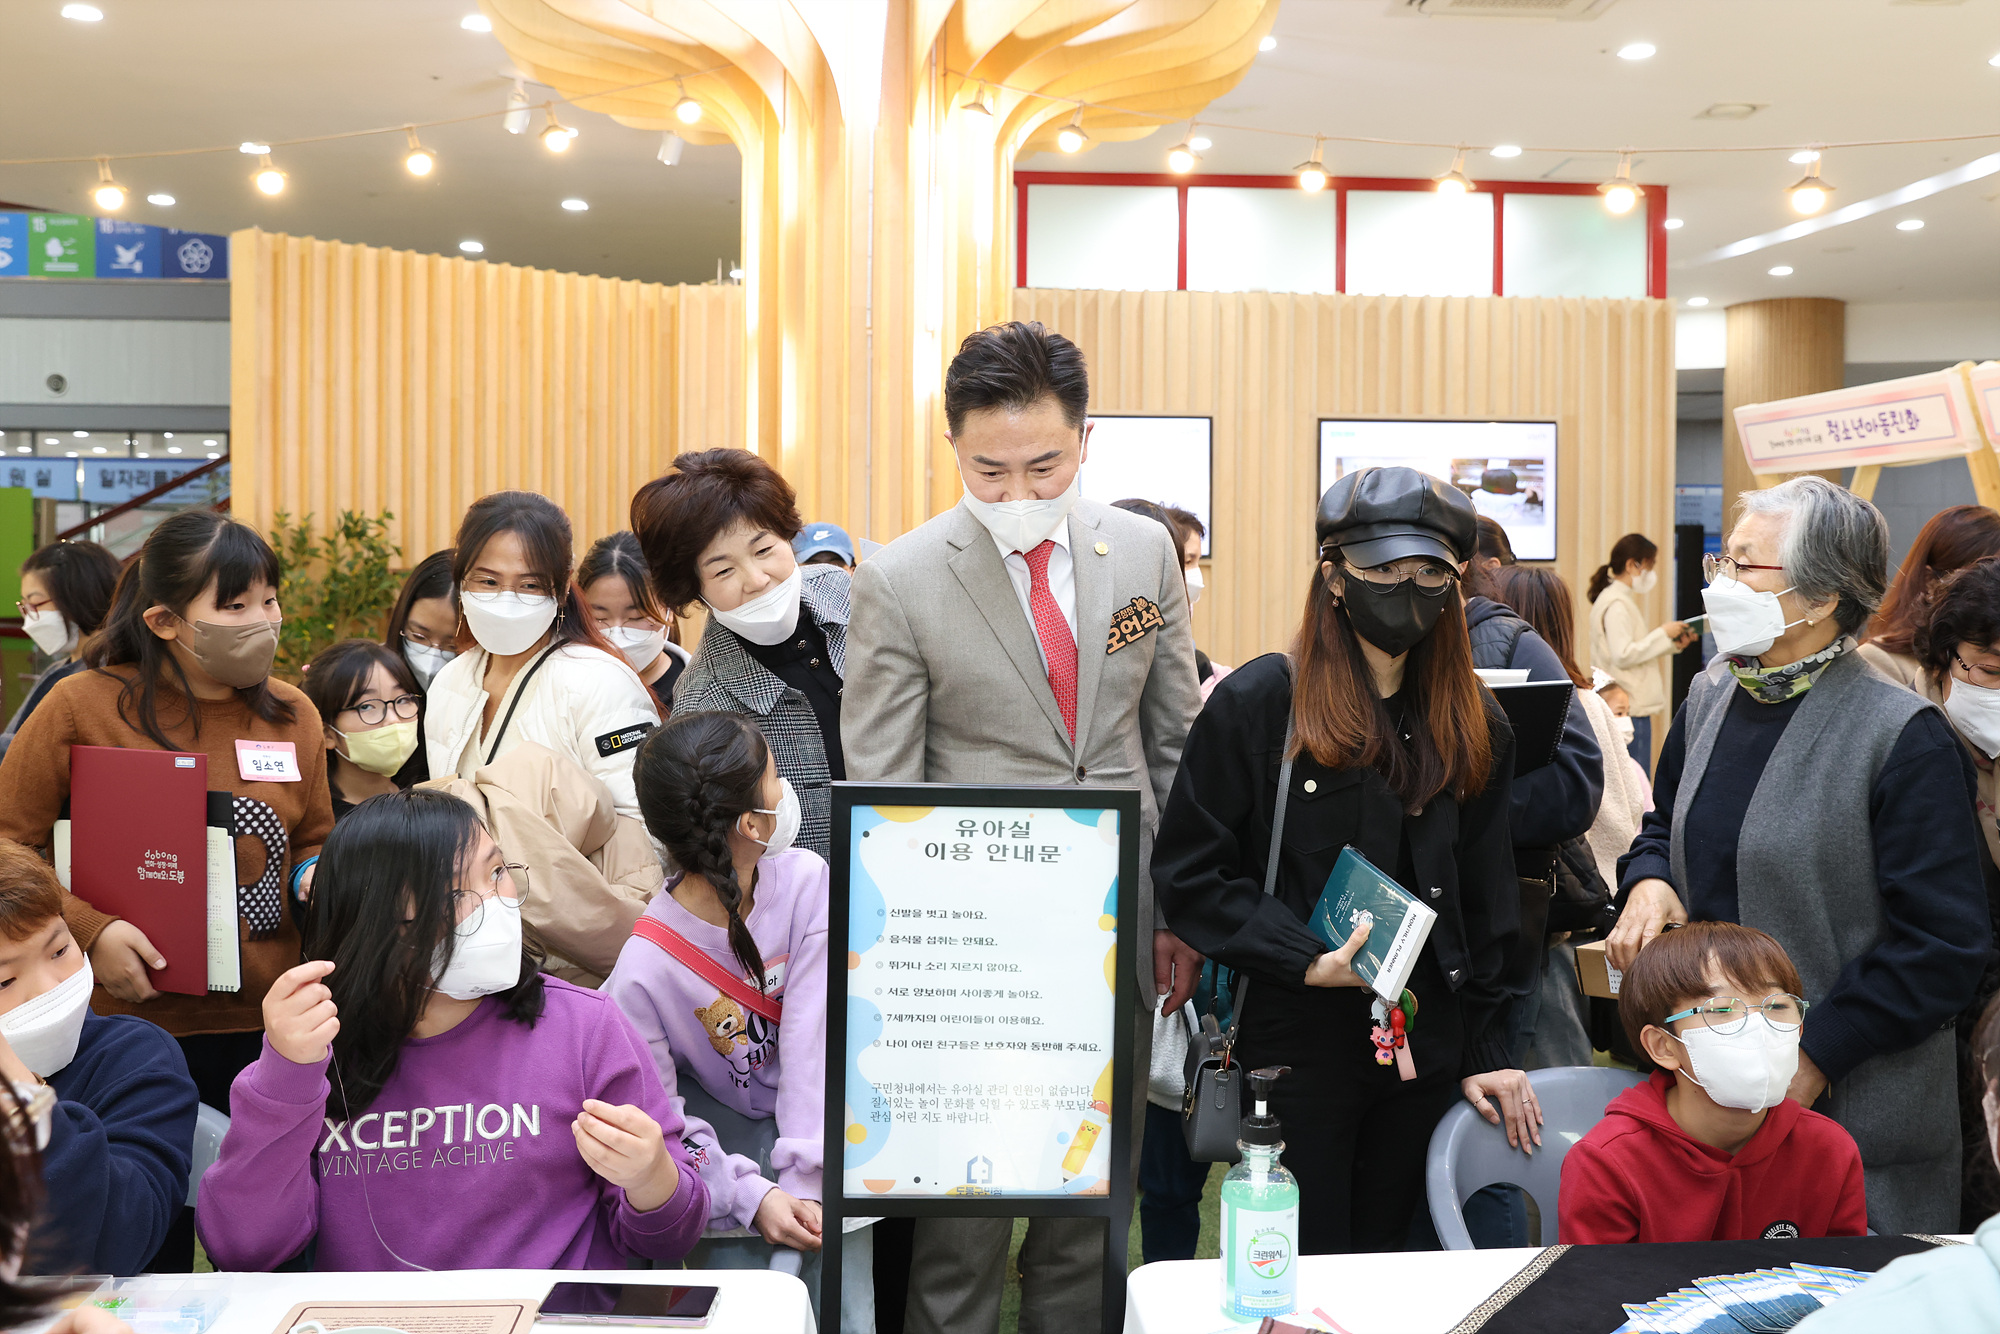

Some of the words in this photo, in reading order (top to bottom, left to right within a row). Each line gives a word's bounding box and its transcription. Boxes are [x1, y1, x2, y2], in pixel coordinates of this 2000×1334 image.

[1107, 604, 1165, 654] 오언석
[620, 730, 642, 739] NATIONAL
[252, 760, 285, 772] 임소연
[955, 819, 1031, 839] 유아실
[144, 849, 177, 862] dobong
[925, 842, 974, 862] 이용
[987, 844, 1061, 864] 안내문
[169, 870, 185, 884] 도봉
[890, 909, 922, 918] 신발을
[926, 909, 948, 919] 벗고
[952, 910, 987, 920] 놀아요.
[1400, 913, 1417, 944] MONTHLY
[889, 935, 922, 944] 음식물
[926, 936, 959, 945] 섭취는
[962, 936, 998, 946] 안돼요.
[1387, 944, 1403, 973] PLANNER
[889, 961, 921, 970] 뛰거나
[925, 962, 947, 971] 소리
[951, 962, 983, 972] 지르지
[986, 963, 1022, 973] 않아요.
[887, 987, 909, 996] 서로
[913, 988, 957, 997] 양보하며
[960, 988, 1003, 998] 사이좋게
[1007, 990, 1043, 999] 놀아요.
[886, 1014, 936, 1023] 7세까지의
[940, 1015, 994, 1024] 어린이들이
[998, 1016, 1044, 1026] 이용해요.
[886, 1039, 907, 1049] 나이
[911, 1040, 933, 1049] 어린
[936, 1040, 980, 1050] 친구들은
[984, 1041, 1027, 1051] 보호자와
[1030, 1041, 1062, 1051] 동반해
[1066, 1042, 1101, 1052] 주세요.
[871, 1082, 947, 1095] 구민청내에서는
[951, 1083, 983, 1096] 유아실
[987, 1084, 1008, 1096] 관리
[1012, 1084, 1044, 1097] 인원이
[1048, 1085, 1093, 1098] 없습니다.
[870, 1096, 914, 1109] 질서있는
[917, 1097, 939, 1109] 놀이
[943, 1097, 975, 1109] 문화를
[1004, 1098, 1016, 1110] 수
[1019, 1098, 1051, 1110] 있도록
[1055, 1099, 1097, 1111] 부모님의
[870, 1111, 891, 1123] 관심
[895, 1111, 917, 1123] 어린
[921, 1111, 942, 1123] 지도
[946, 1112, 992, 1124] 바랍니다.
[320, 1150, 423, 1177] VINTAGE
[431, 1142, 515, 1168] ACHIVE
